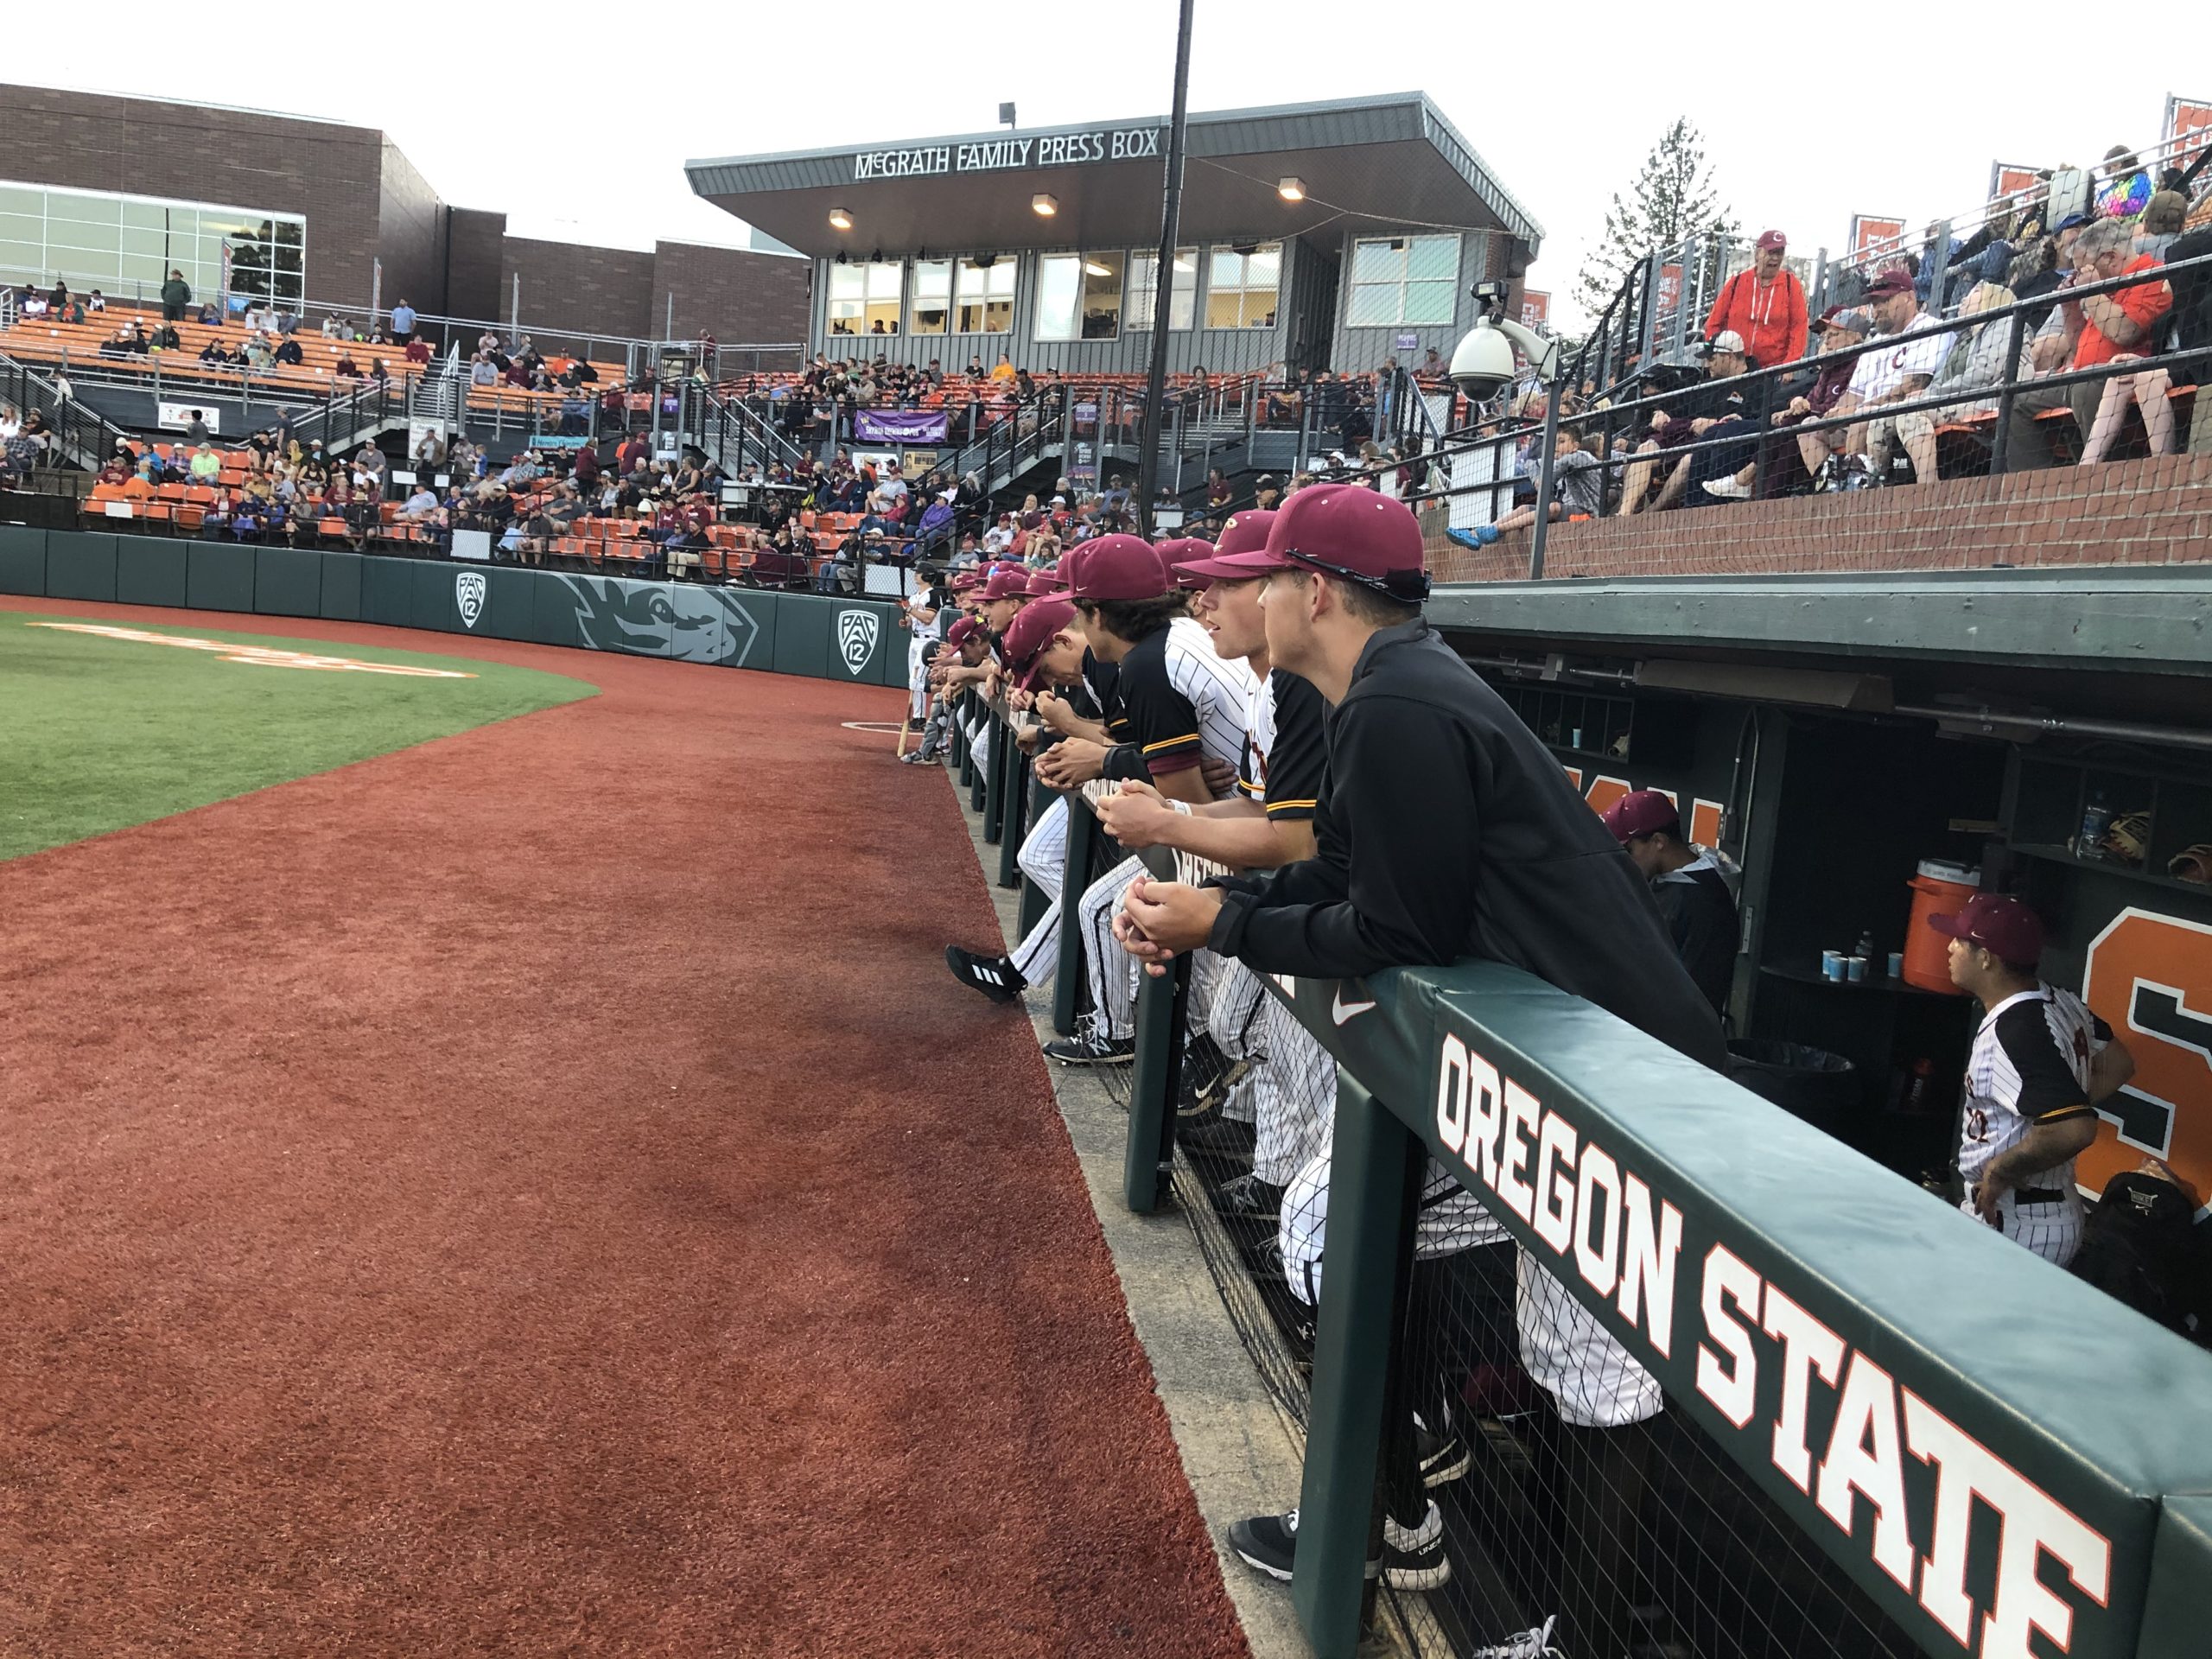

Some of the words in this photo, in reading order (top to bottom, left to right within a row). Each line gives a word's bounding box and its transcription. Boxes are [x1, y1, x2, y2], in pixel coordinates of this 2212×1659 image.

[957, 138, 1033, 172] FAMILY
[1038, 132, 1105, 165] PRESS
[1110, 128, 1160, 160] BOX
[1772, 232, 1783, 242] C
[1892, 346, 1906, 369] C
[954, 575, 963, 586] C
[464, 601, 476, 616] 12
[849, 643, 865, 662] 12
[1436, 1031, 1684, 1361] OREGON
